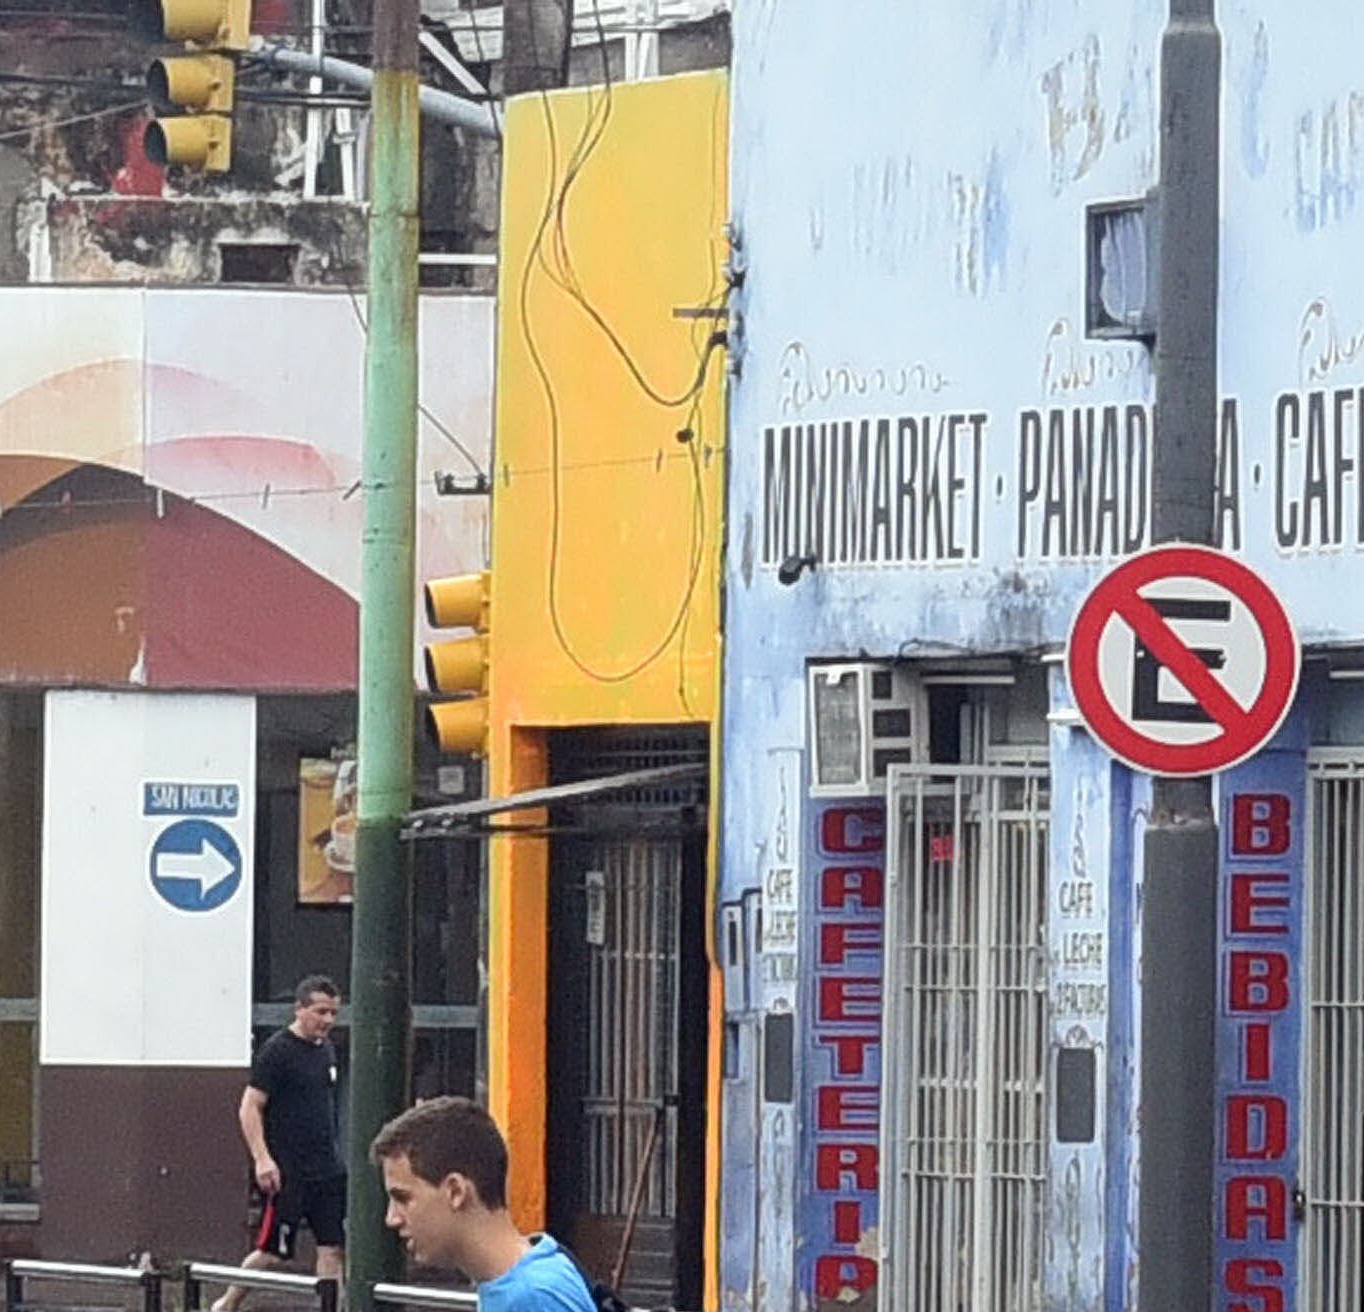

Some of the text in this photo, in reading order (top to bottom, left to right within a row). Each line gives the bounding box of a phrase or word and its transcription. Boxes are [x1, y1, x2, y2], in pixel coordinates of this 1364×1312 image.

[762, 414, 988, 563] MINIMARKET
[1018, 398, 1241, 558] PANADA
[1133, 598, 1232, 723] E
[1058, 881, 1093, 913] CAFE
